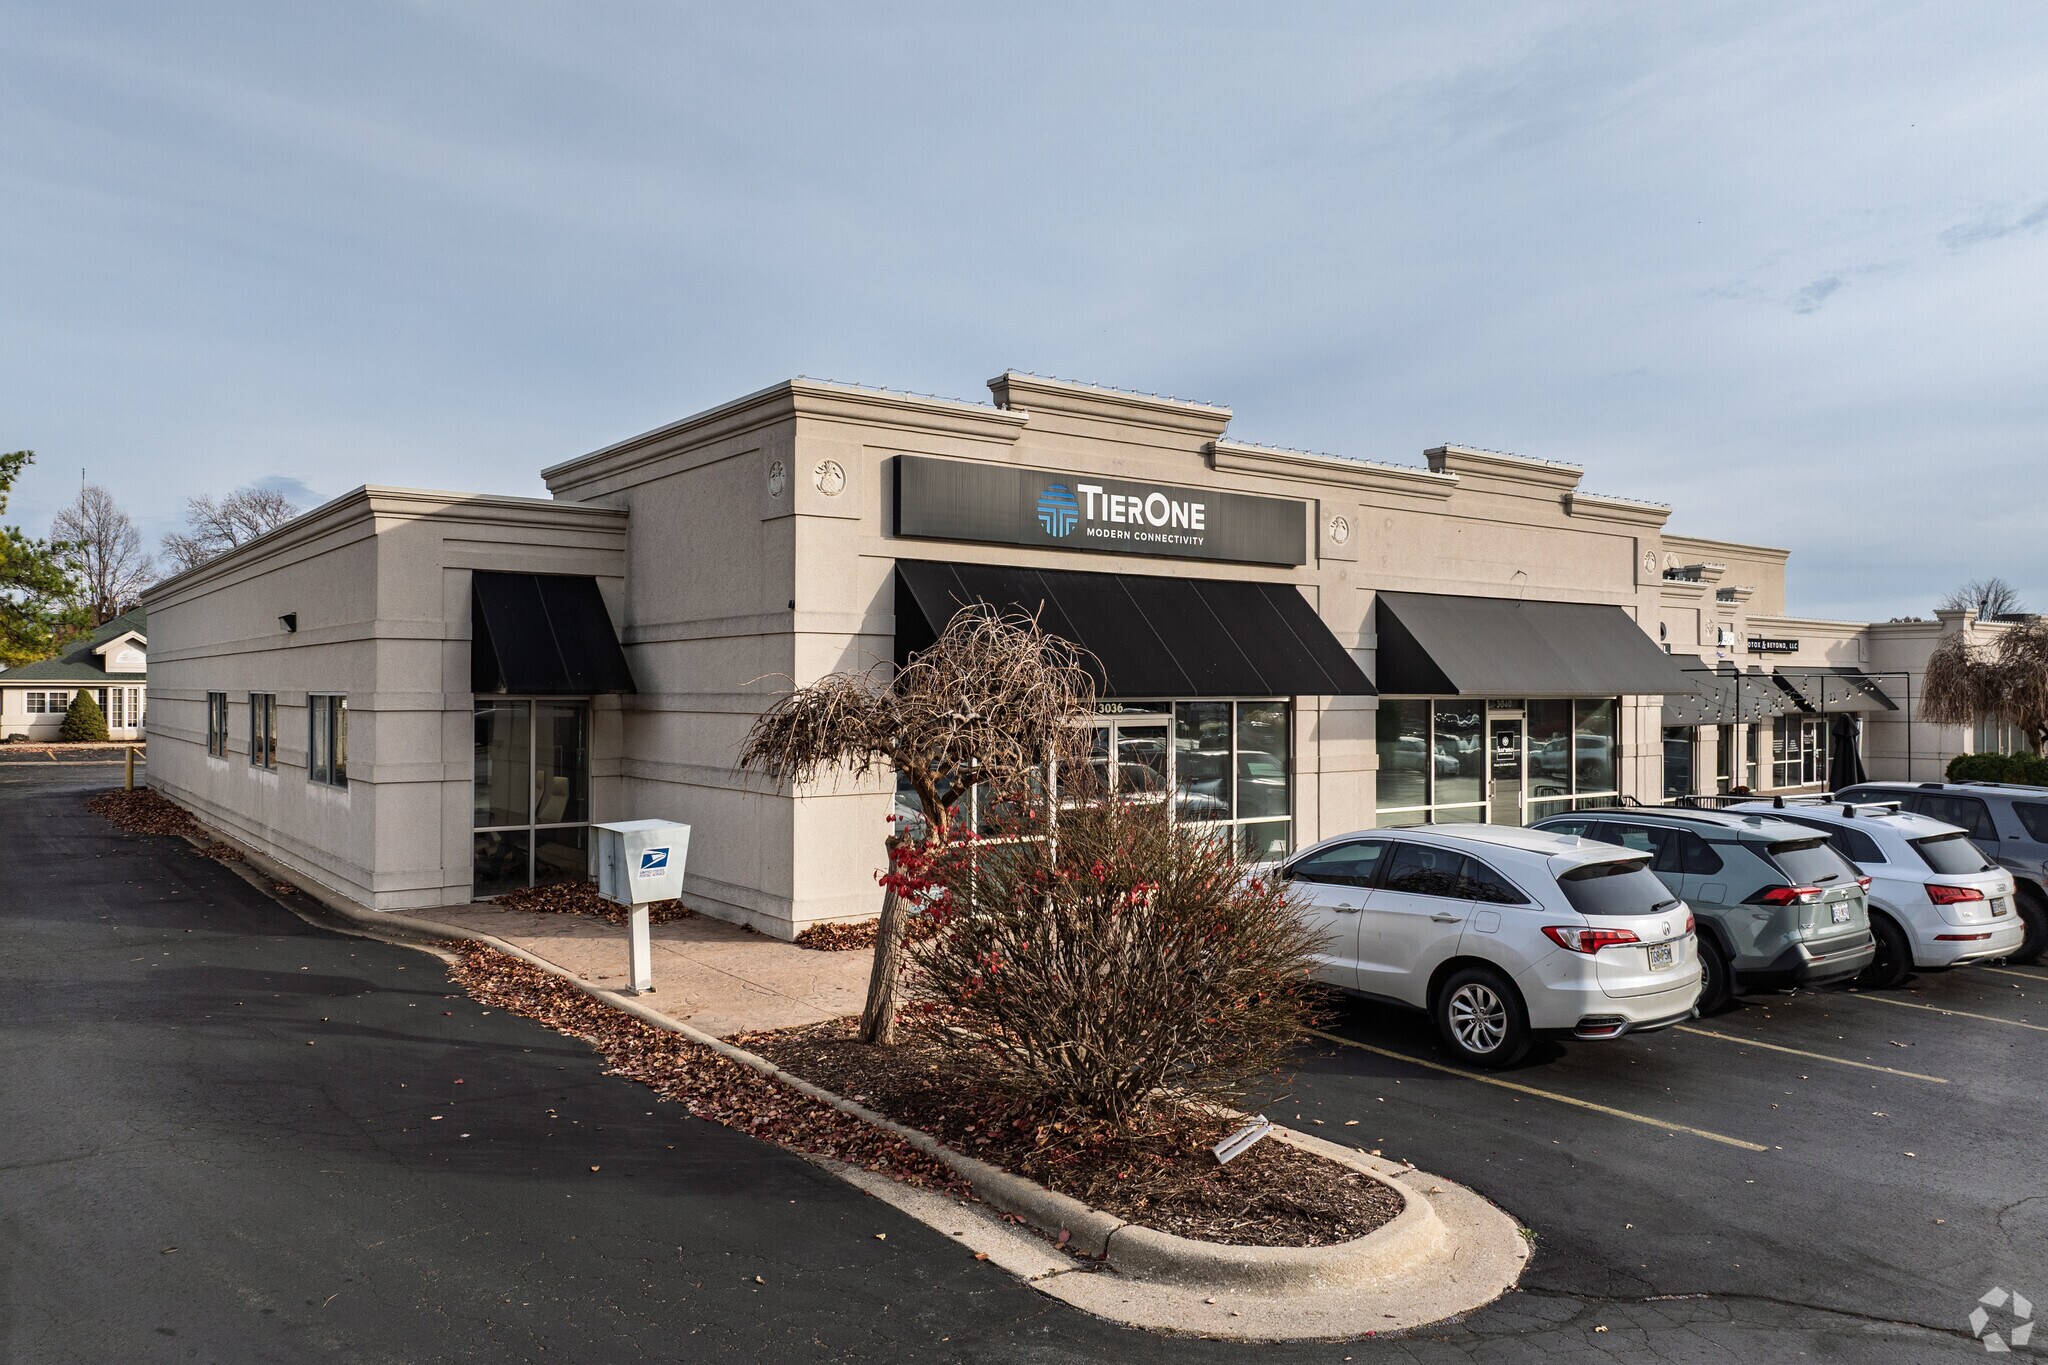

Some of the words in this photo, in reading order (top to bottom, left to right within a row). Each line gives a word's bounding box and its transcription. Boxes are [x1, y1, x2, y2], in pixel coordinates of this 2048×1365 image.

[1086, 527, 1131, 539] MODERN
[1134, 532, 1204, 546] CONNECTIVITY
[1767, 642, 1788, 650] BEYOND,
[1789, 642, 1798, 650] LLC
[1098, 703, 1123, 713] 3036
[1496, 700, 1513, 709] 3040
